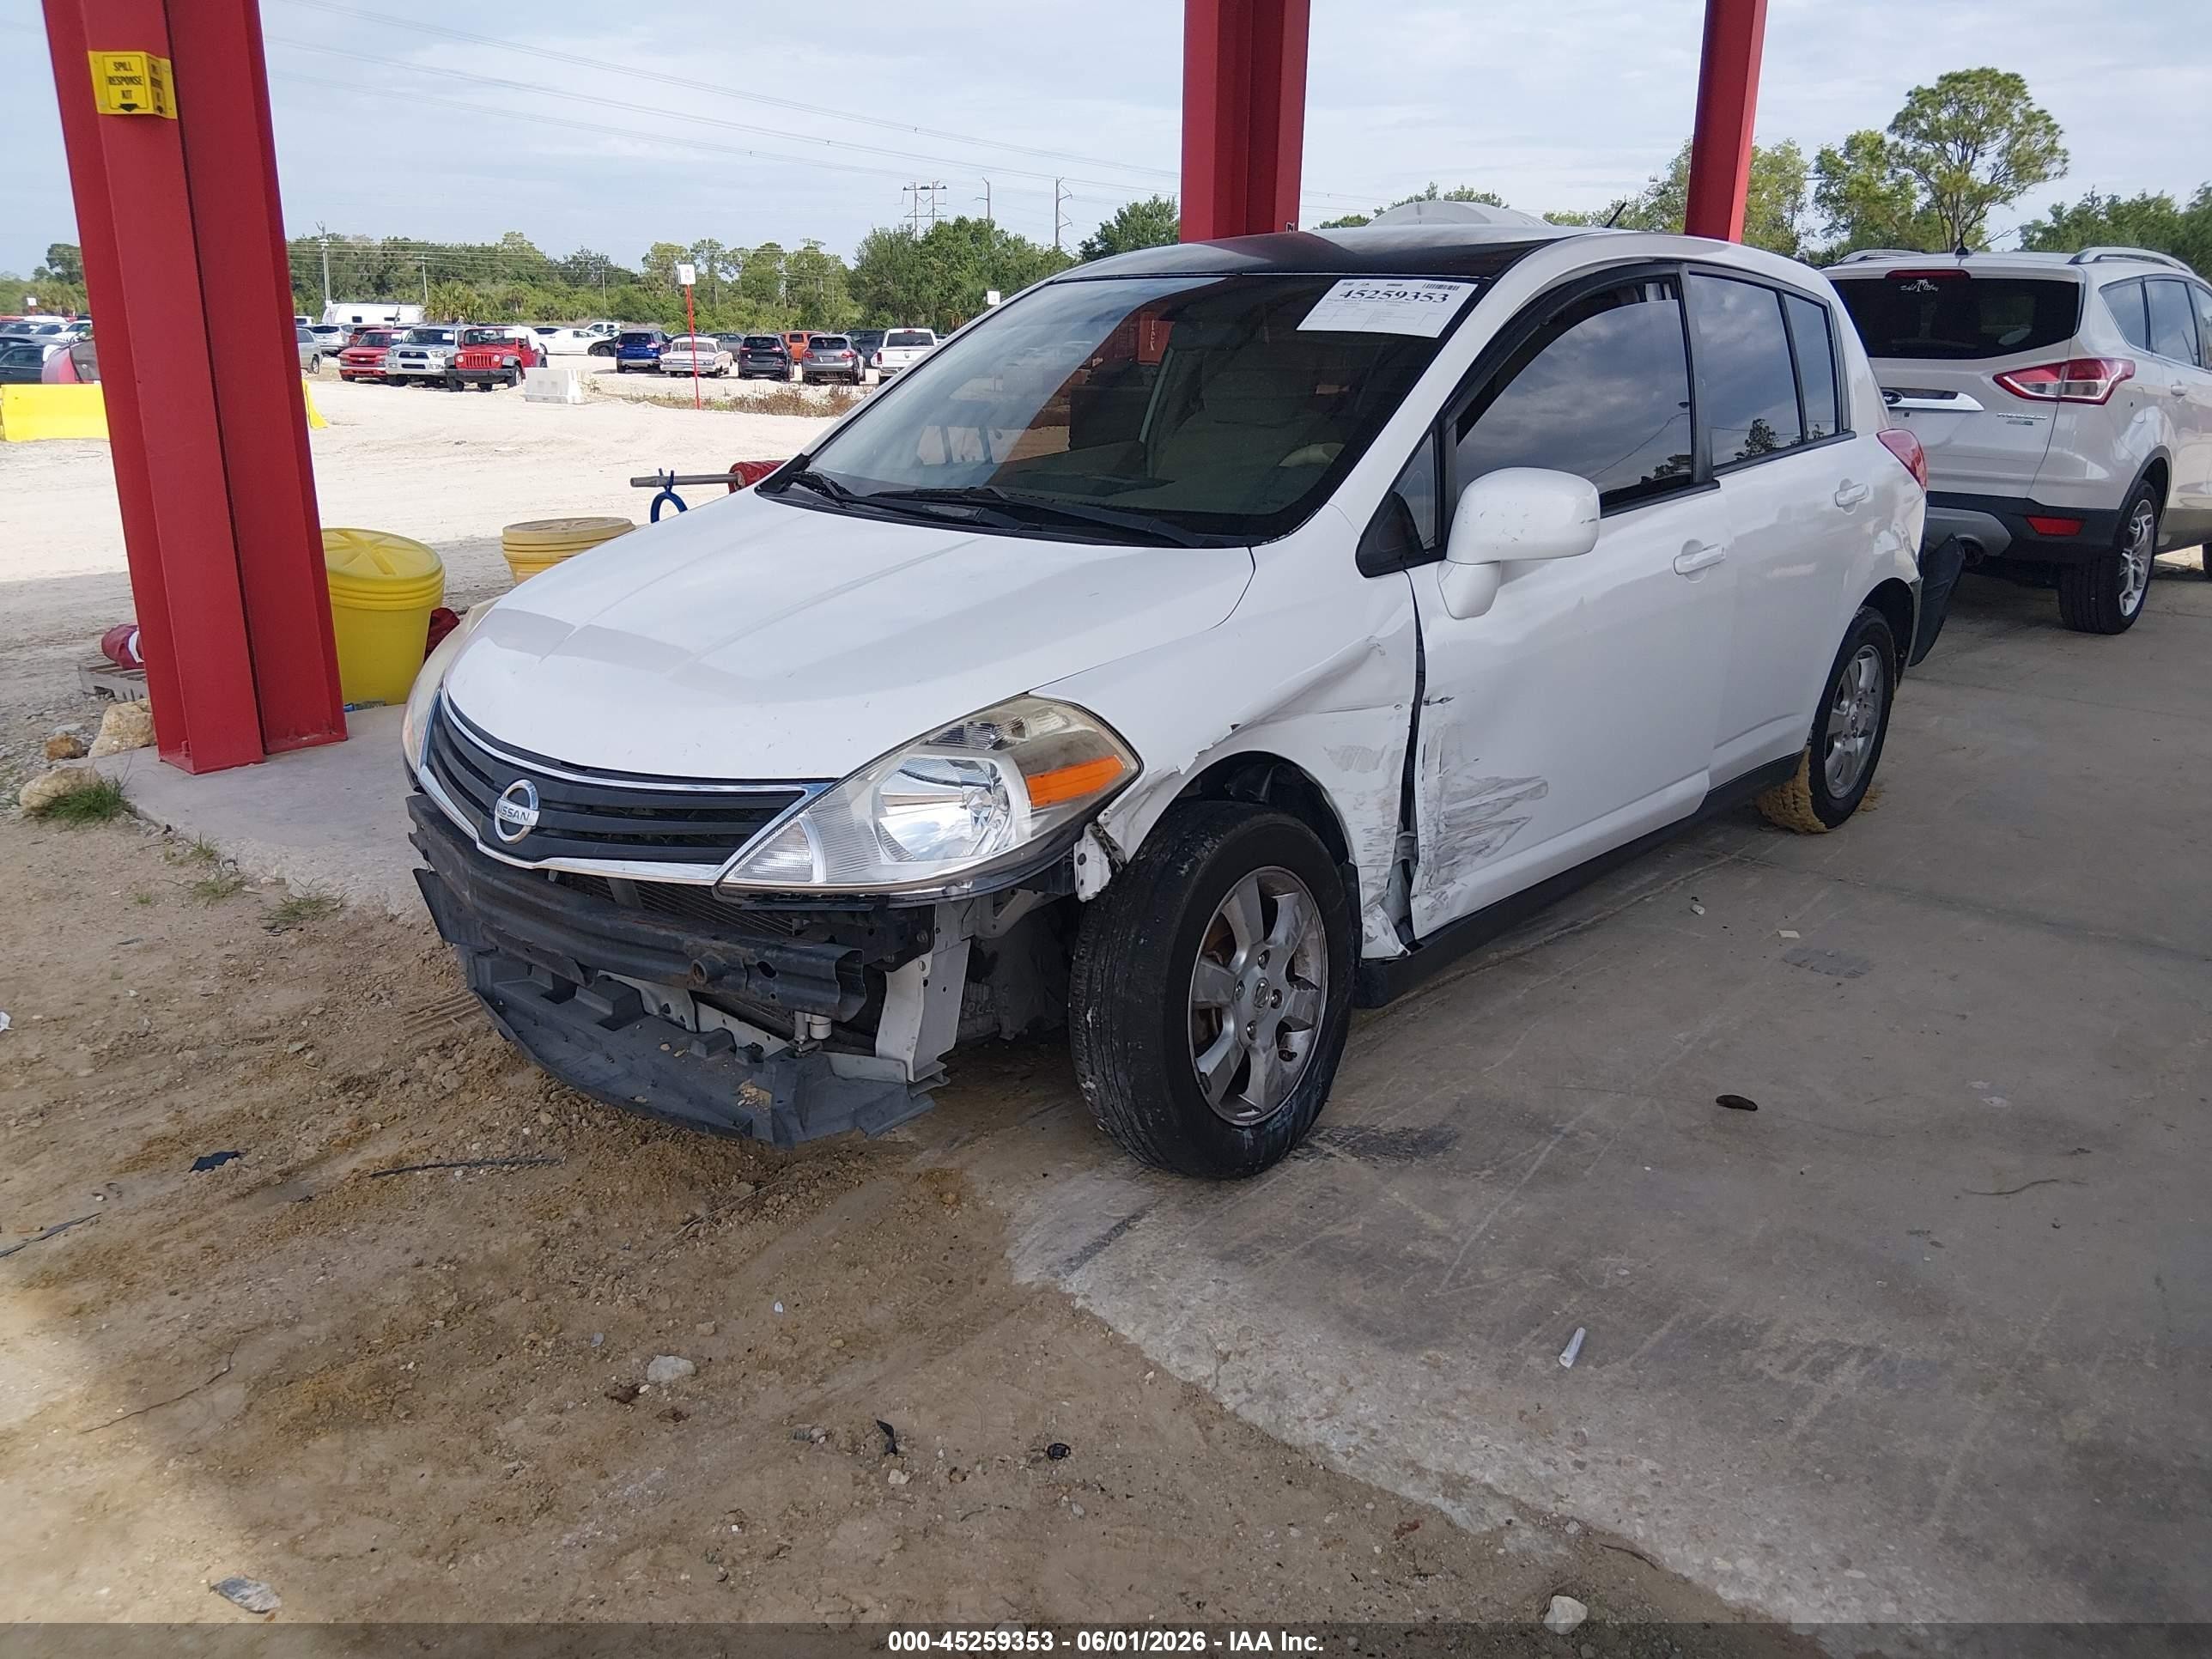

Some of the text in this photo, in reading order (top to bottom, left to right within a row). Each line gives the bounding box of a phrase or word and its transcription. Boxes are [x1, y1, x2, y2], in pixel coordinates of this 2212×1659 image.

[112, 61, 133, 71] SPILL
[106, 76, 143, 86] RESPONSE
[121, 89, 133, 100] KIT
[1340, 289, 1449, 303] 45259353
[497, 800, 530, 822] NISSAN
